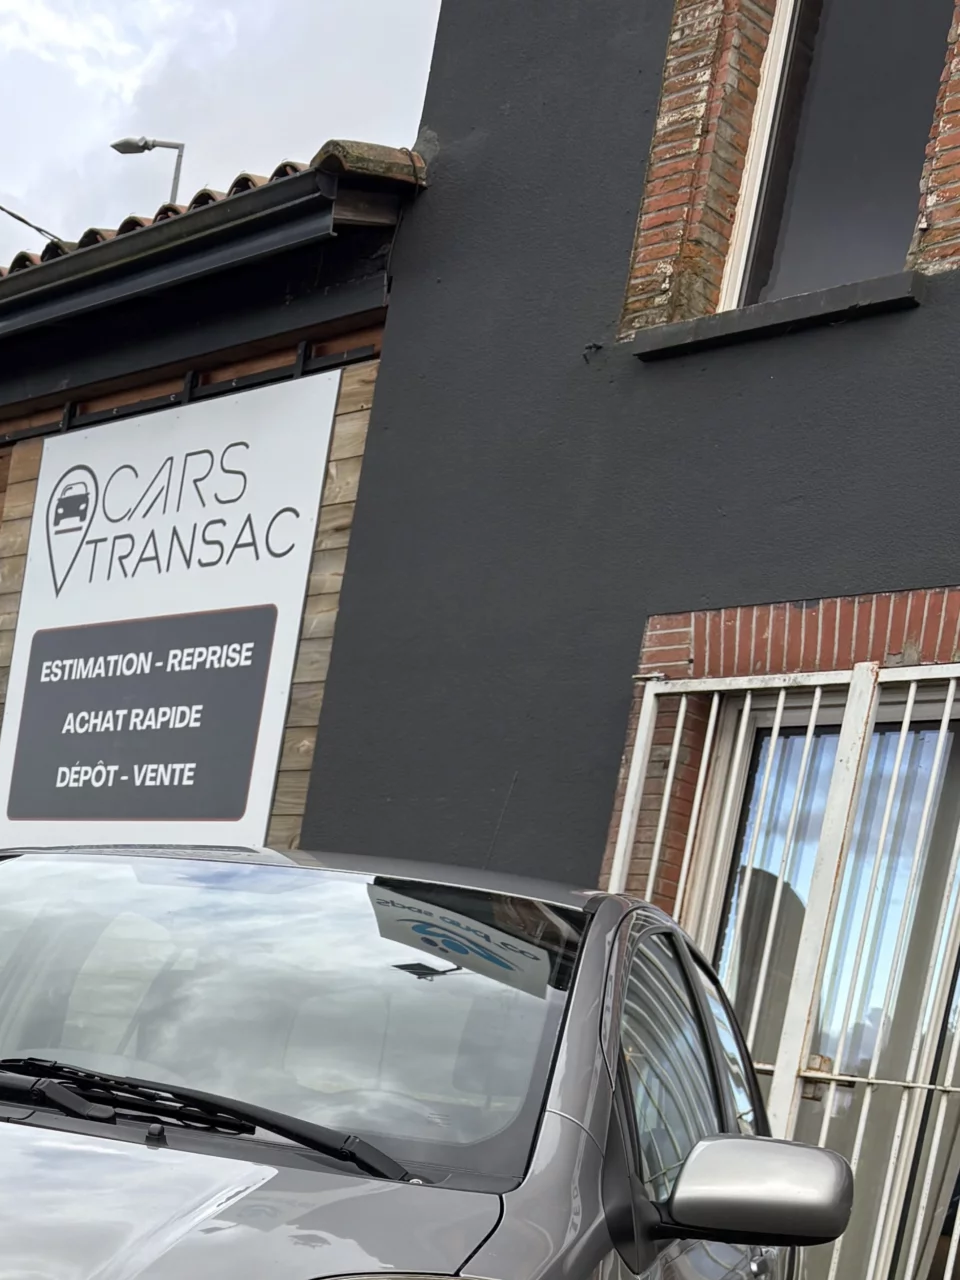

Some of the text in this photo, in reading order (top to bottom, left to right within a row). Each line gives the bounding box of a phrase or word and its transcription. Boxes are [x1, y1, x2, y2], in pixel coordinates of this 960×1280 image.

[102, 441, 251, 524] CARS
[83, 506, 301, 584] TRANSAC
[40, 650, 152, 683] ESTIMATION
[166, 642, 255, 673] REPRISE
[61, 704, 203, 734] ACHAT RAPIDE
[55, 760, 120, 788] DÉPÔT
[132, 763, 196, 786] VENTE
